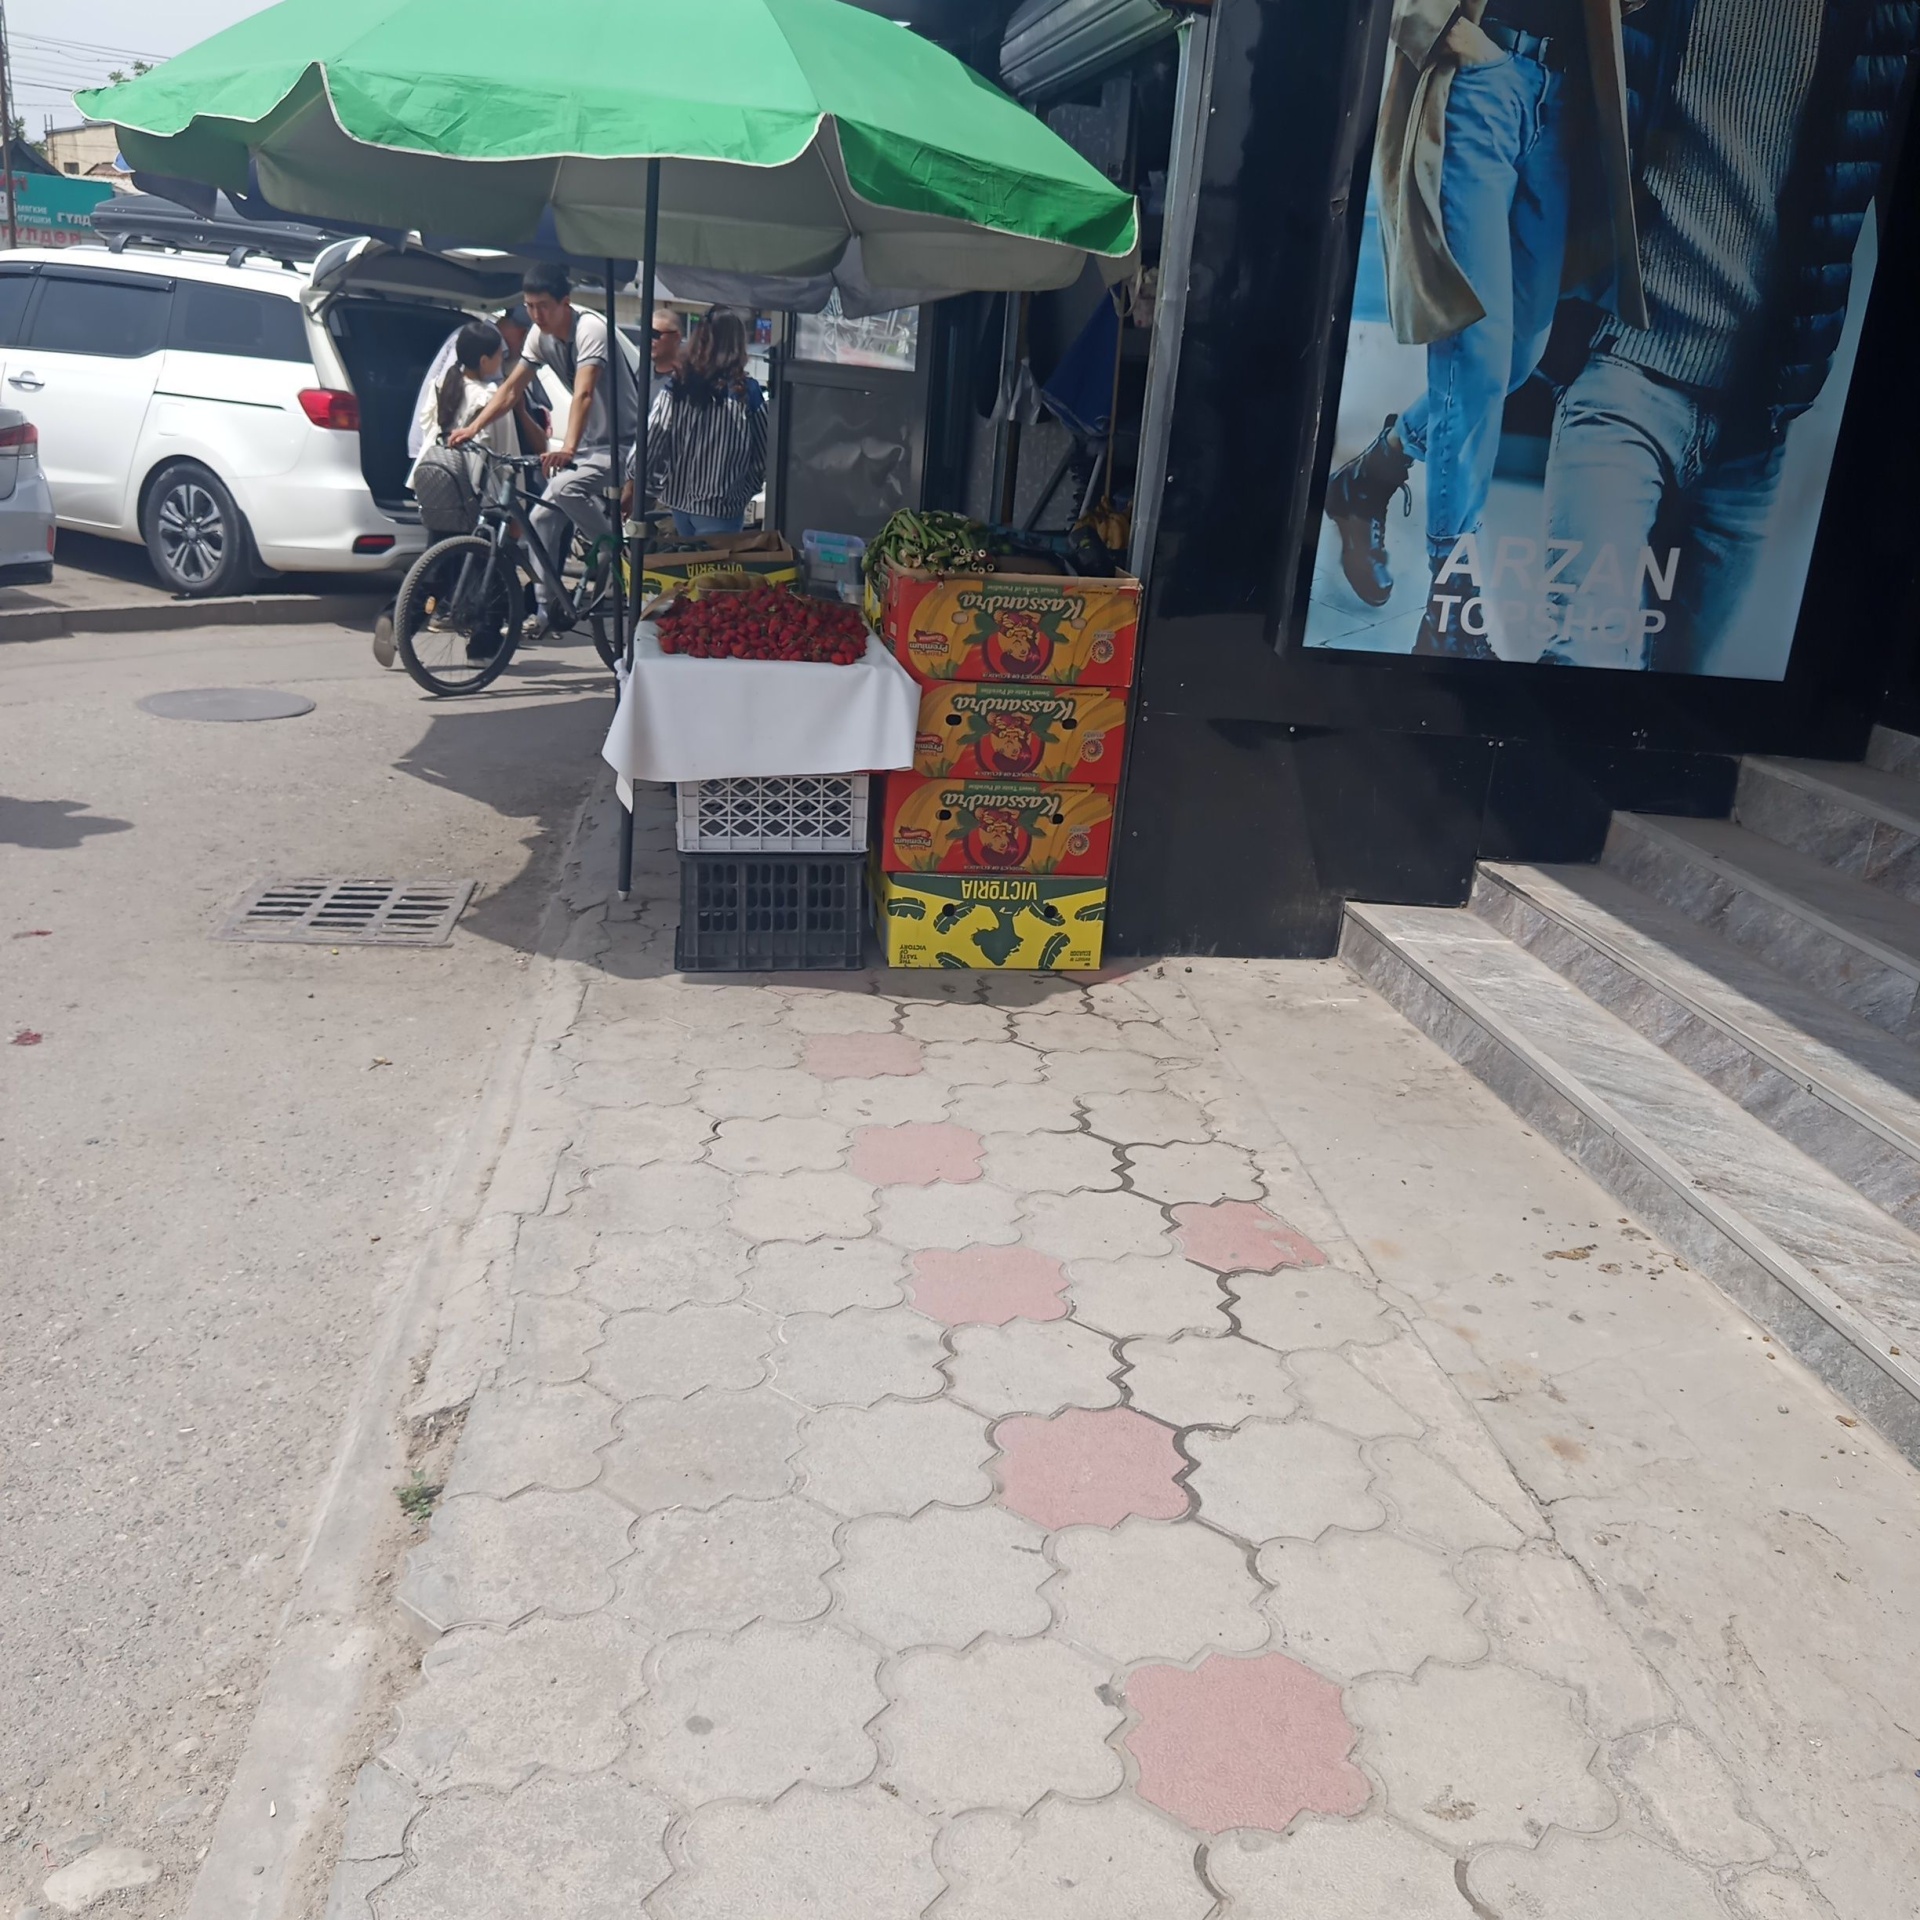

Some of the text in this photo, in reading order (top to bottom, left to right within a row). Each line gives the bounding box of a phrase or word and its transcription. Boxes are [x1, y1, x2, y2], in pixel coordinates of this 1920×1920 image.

[57, 212, 92, 227] ГҮЛД
[1434, 532, 1681, 601] ARZAN
[960, 594, 1083, 621] Kassandra
[1432, 594, 1667, 647] TOPSHOP
[909, 642, 948, 653] Premium
[954, 696, 1074, 721] Kassandra
[915, 741, 943, 752] Premi
[942, 793, 1060, 817] Kassandra
[894, 837, 931, 847] Premium
[961, 880, 1038, 901] VICTORIA
